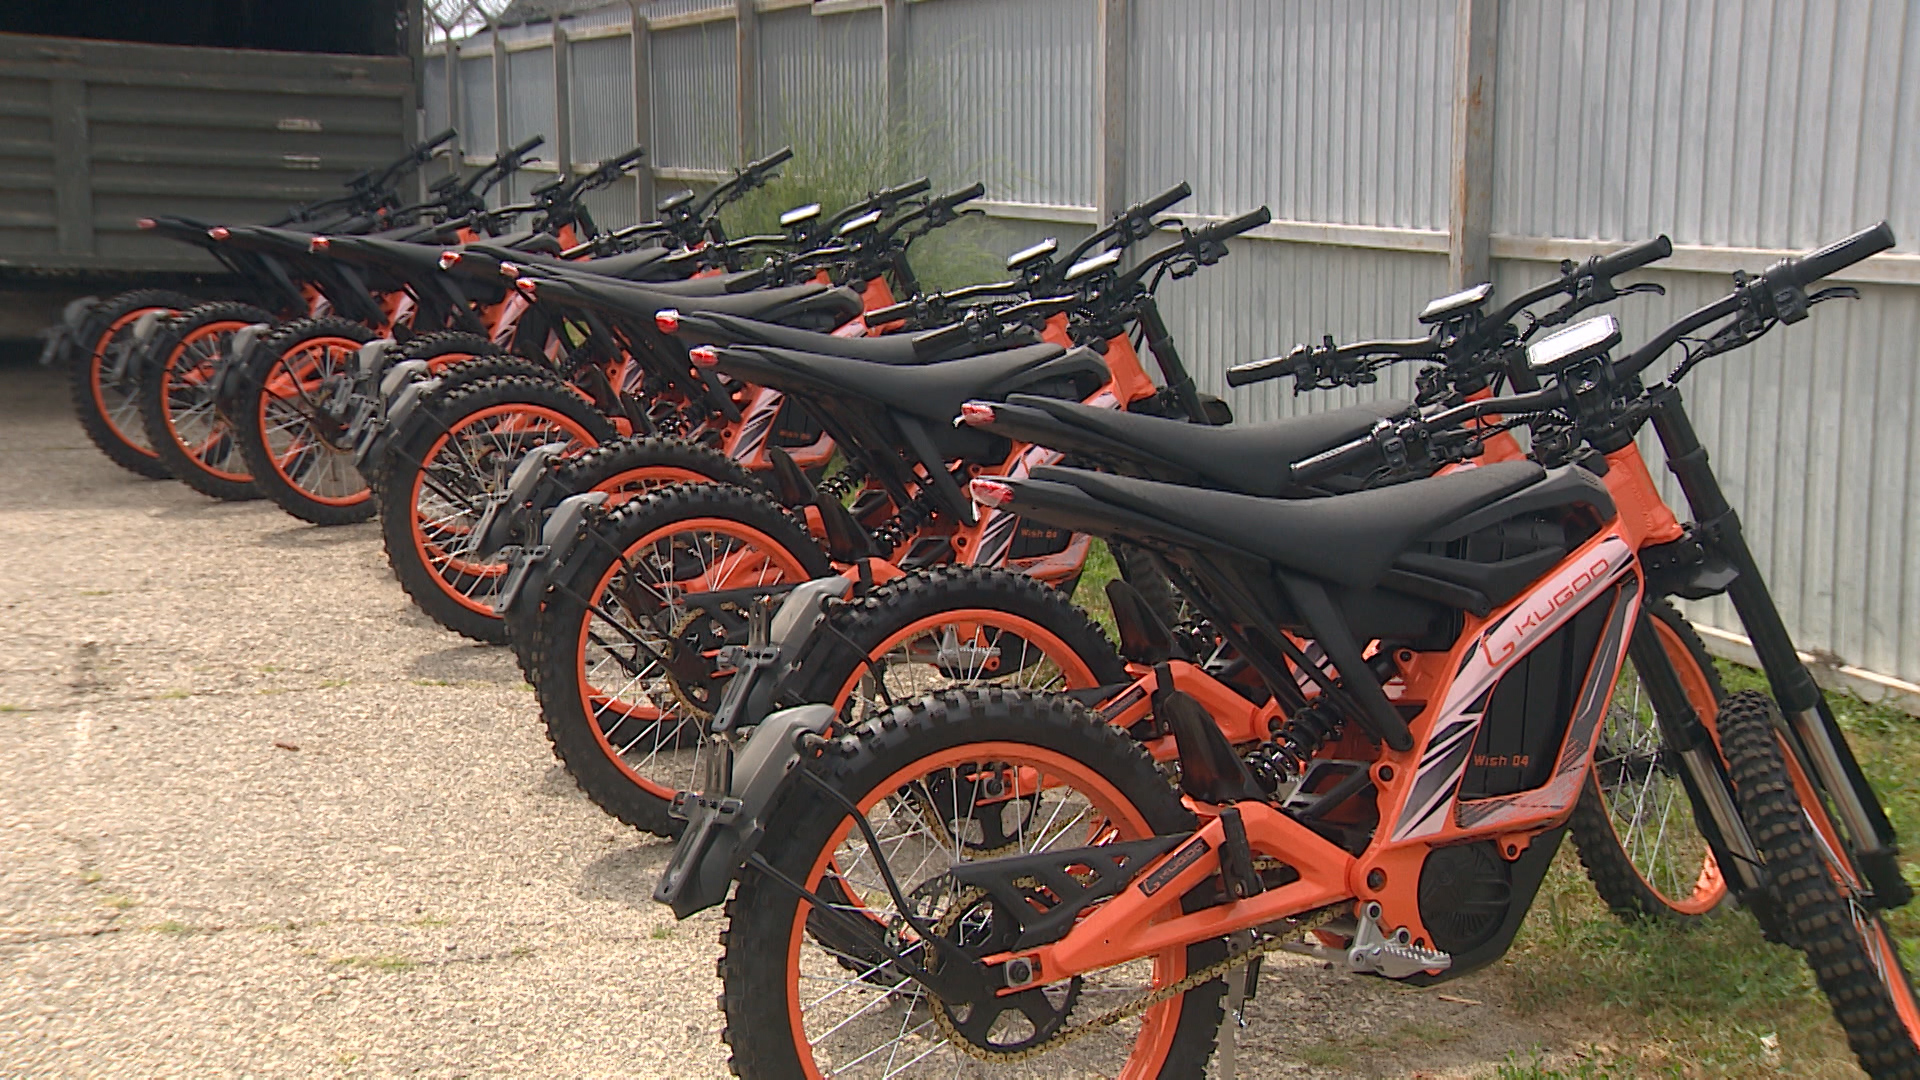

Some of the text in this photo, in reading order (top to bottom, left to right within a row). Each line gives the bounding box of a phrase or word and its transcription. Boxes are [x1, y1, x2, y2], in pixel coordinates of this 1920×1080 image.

[1514, 558, 1609, 637] KUGOO
[1474, 755, 1529, 767] Wish 04
